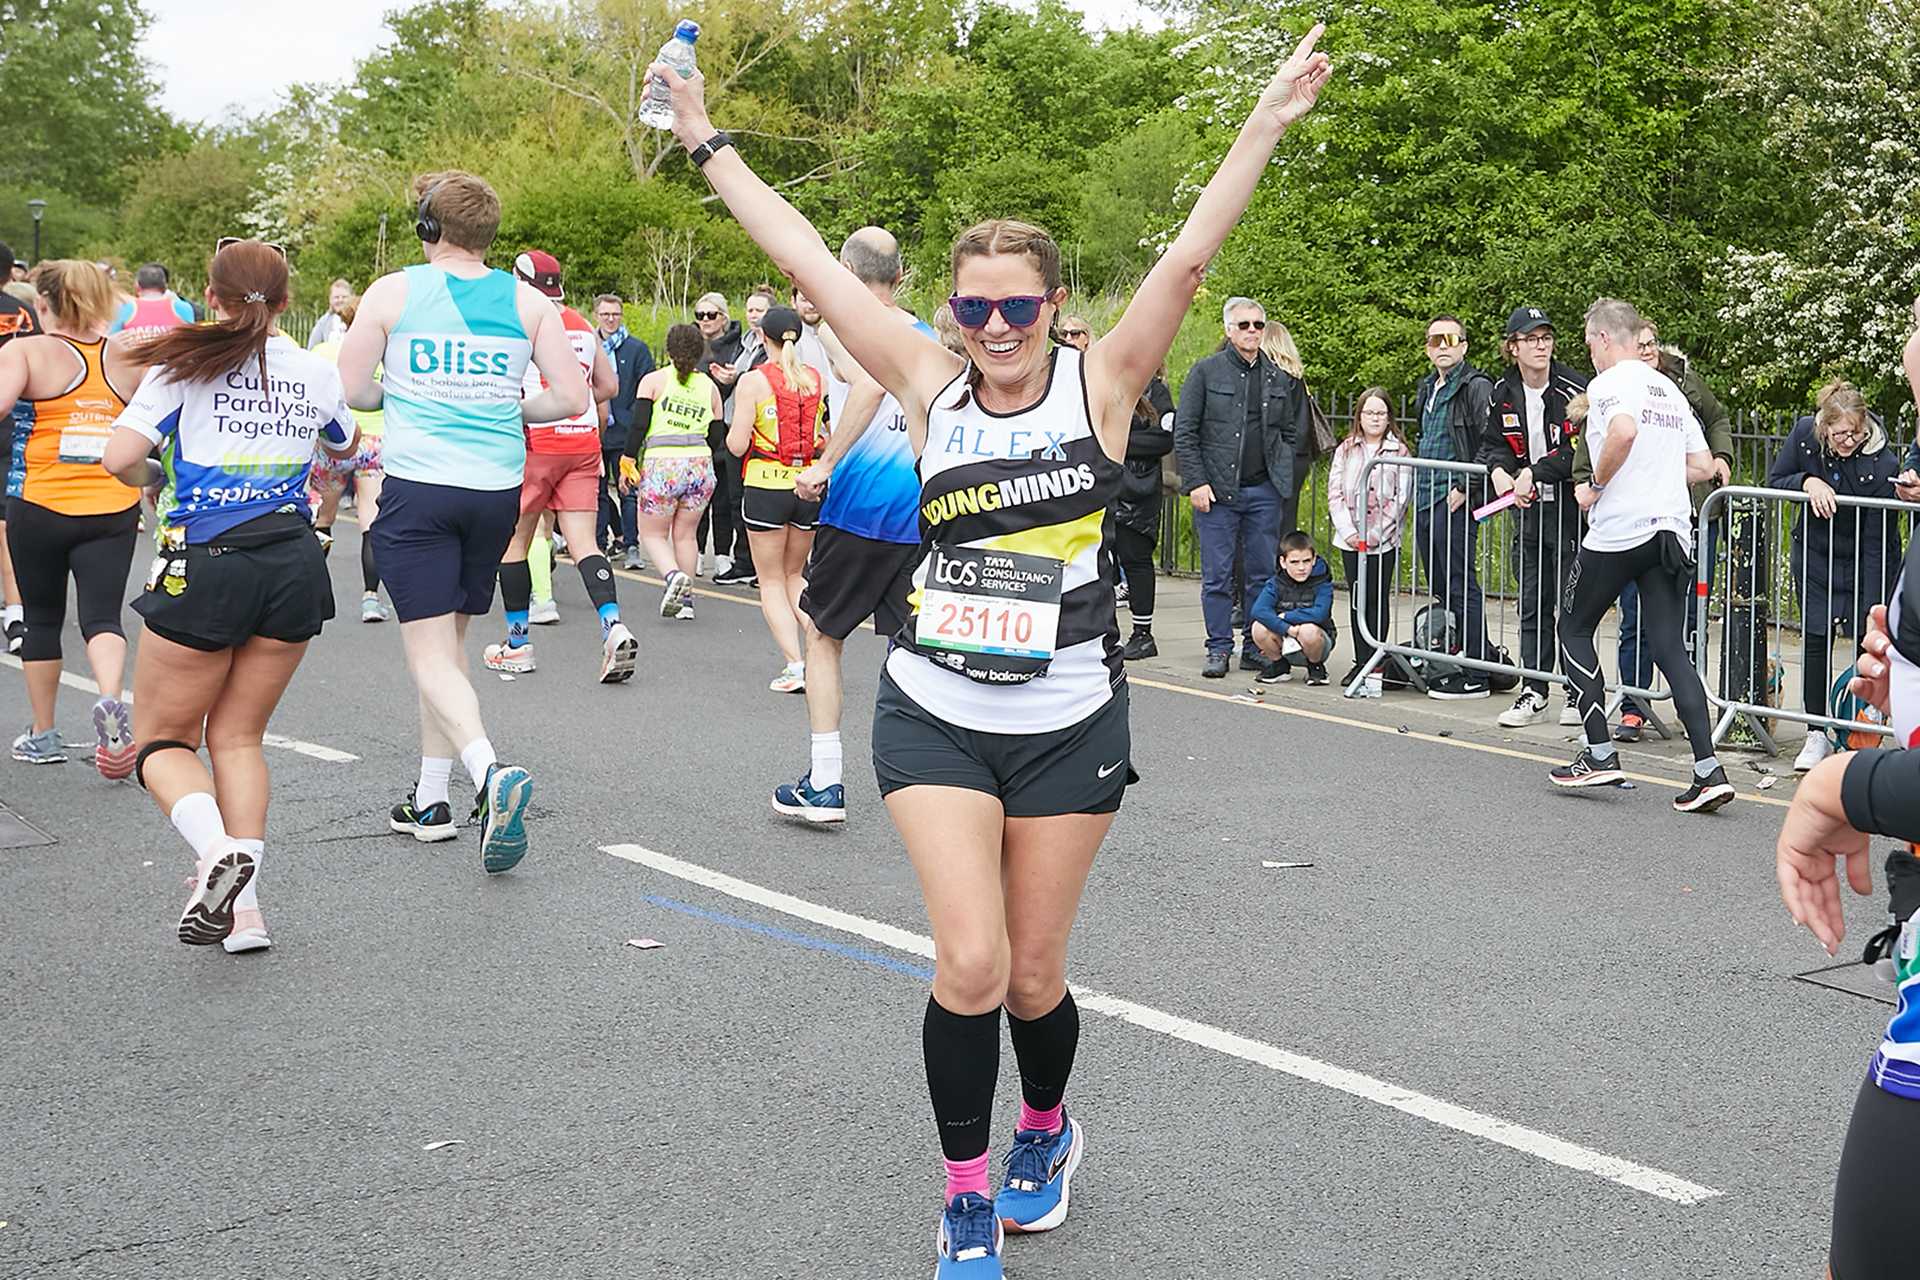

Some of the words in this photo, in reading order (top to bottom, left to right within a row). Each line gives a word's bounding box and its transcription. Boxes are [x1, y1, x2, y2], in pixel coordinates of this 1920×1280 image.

[410, 338, 509, 376] Bliss
[213, 393, 319, 419] Paralysis
[213, 415, 315, 439] Together
[944, 425, 1066, 459] ALEX
[921, 463, 1096, 526] YOUNGMINDS
[983, 556, 1015, 569] TATA
[980, 578, 1027, 592] SERVICES
[982, 567, 1055, 585] CONSULTANCY
[936, 603, 1033, 644] 25110
[966, 667, 988, 680] new
